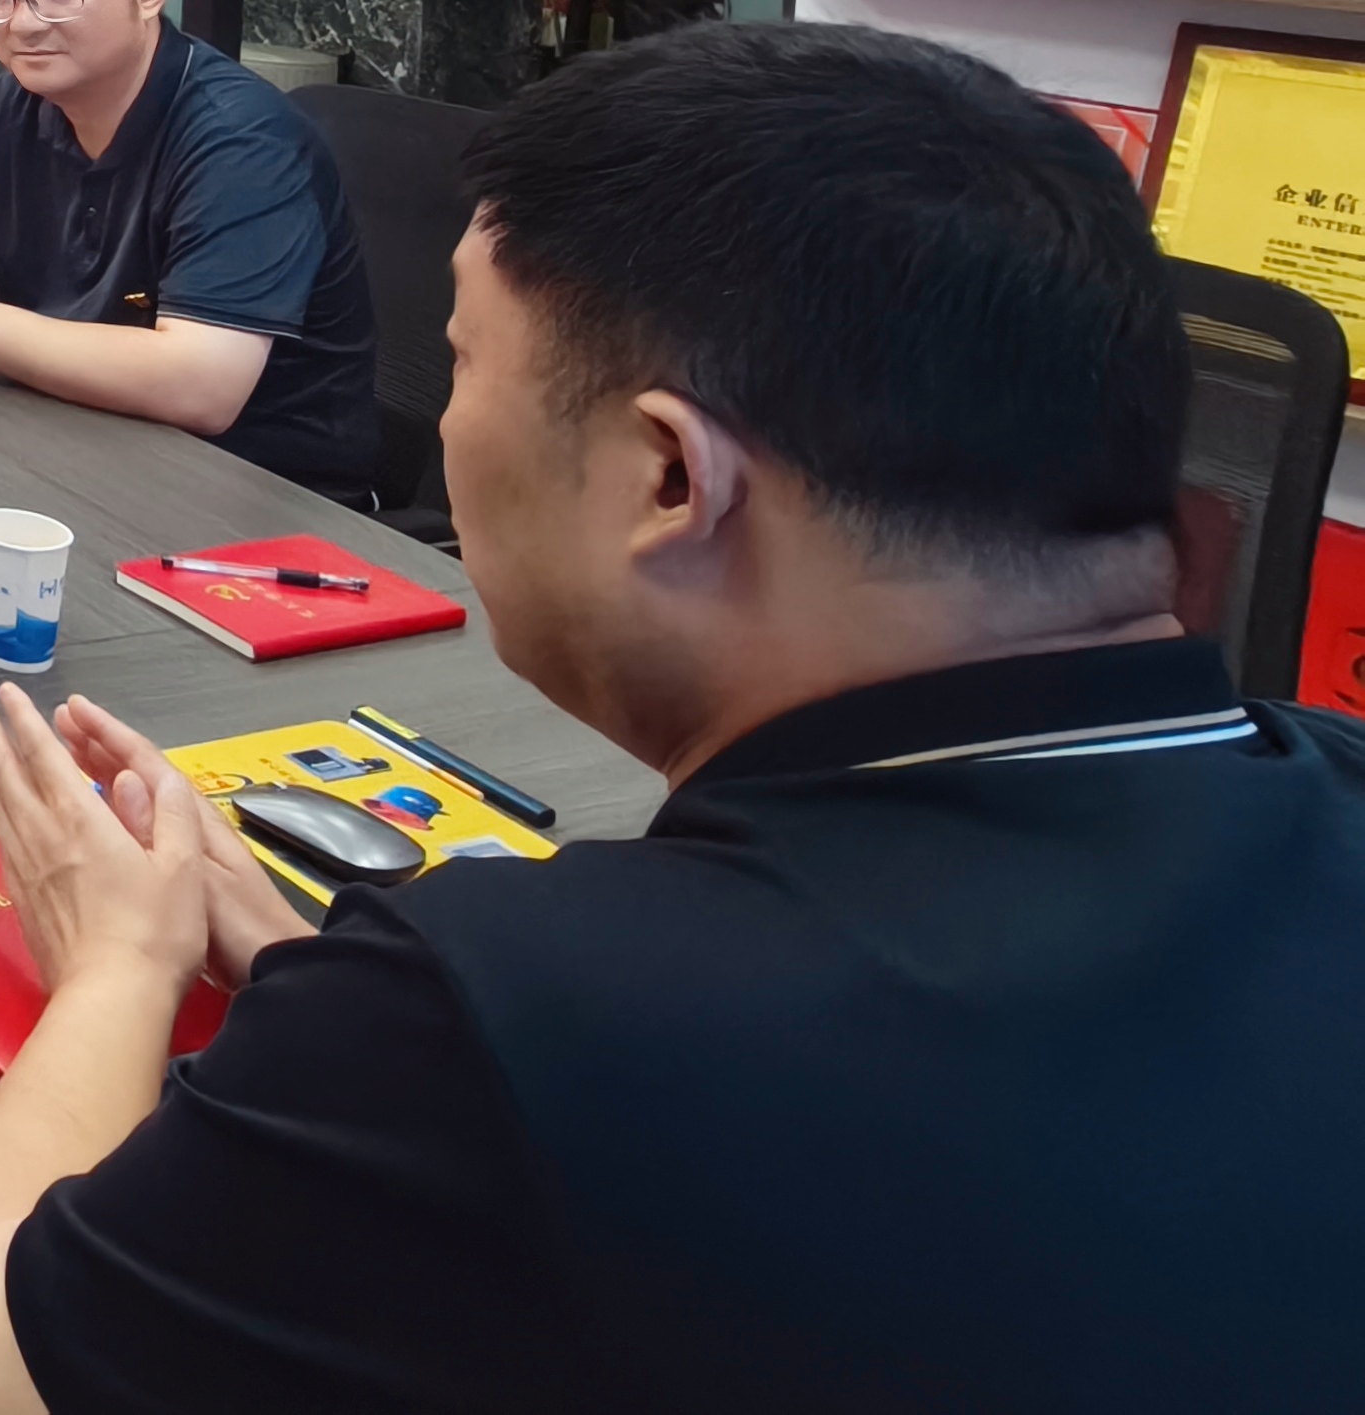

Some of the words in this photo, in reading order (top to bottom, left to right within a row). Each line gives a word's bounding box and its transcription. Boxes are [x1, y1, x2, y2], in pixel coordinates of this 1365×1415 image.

[1274, 184, 1365, 216] 企业信
[1297, 215, 1365, 236] ENTER
